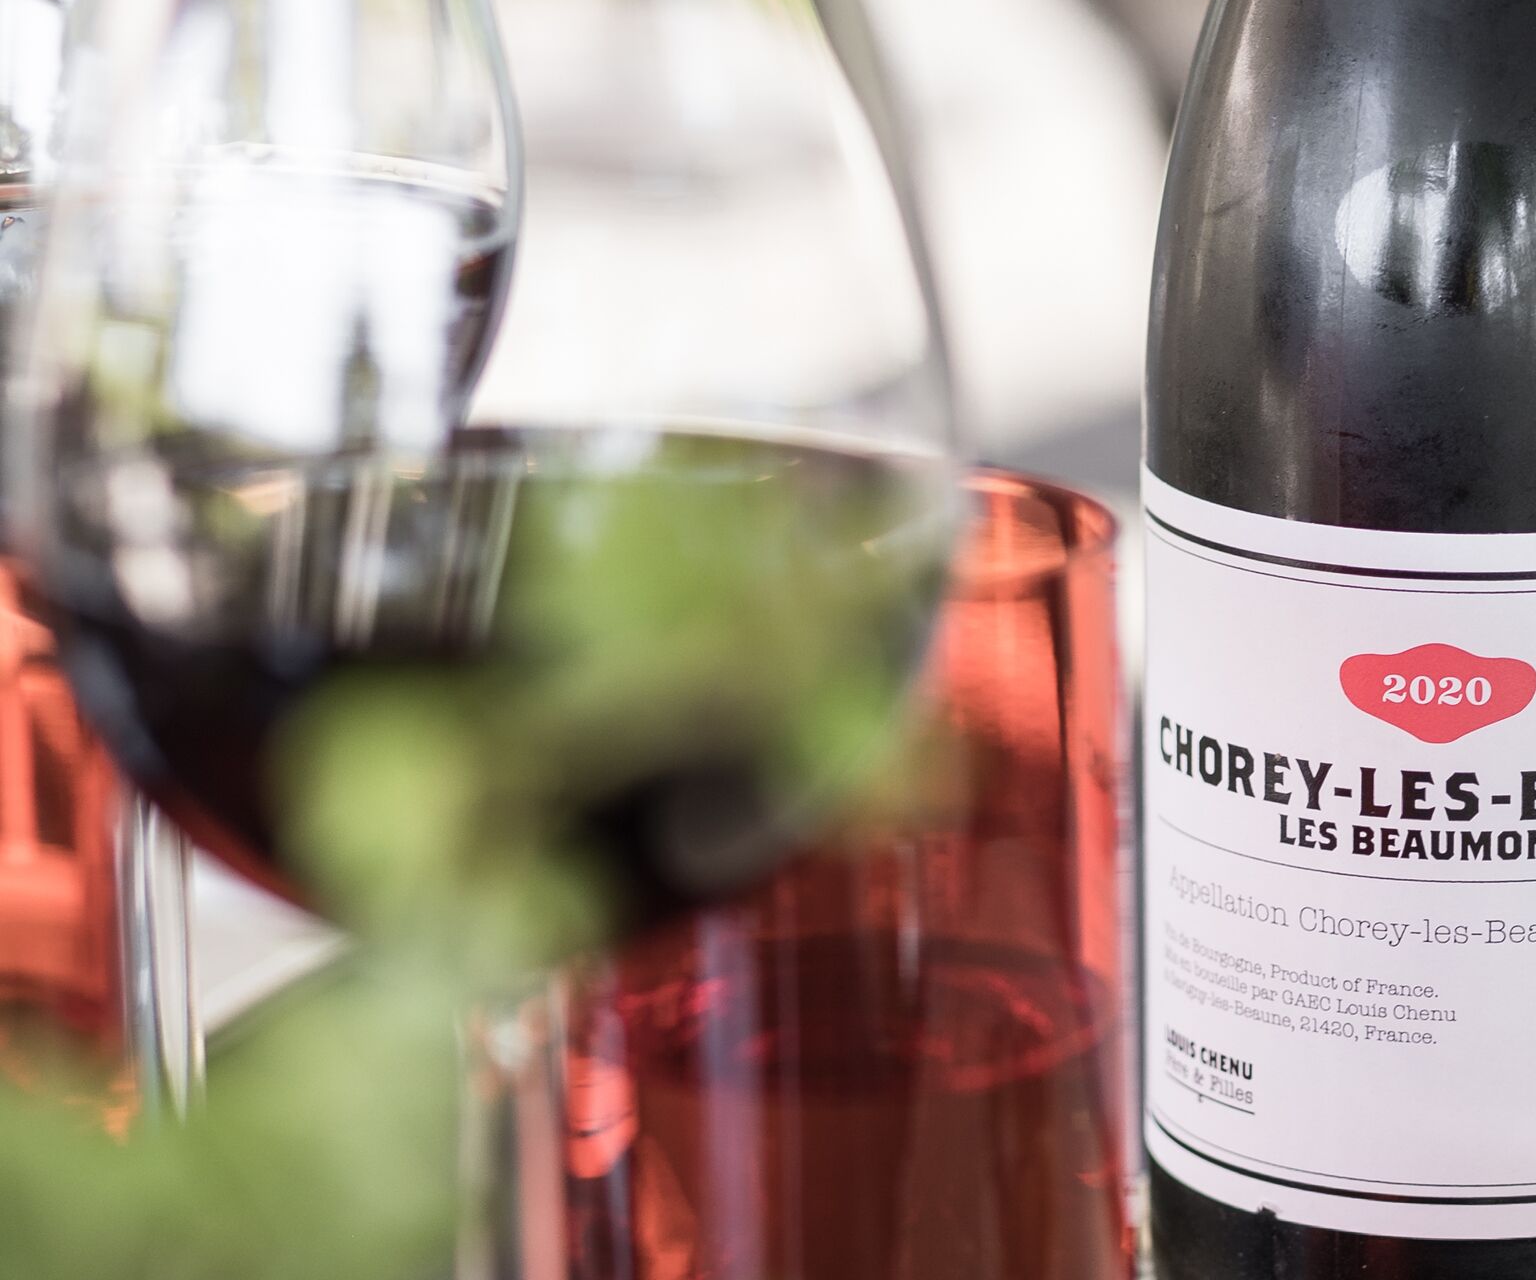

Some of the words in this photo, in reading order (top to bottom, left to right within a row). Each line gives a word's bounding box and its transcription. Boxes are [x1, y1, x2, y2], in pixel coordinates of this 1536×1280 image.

[1382, 673, 1493, 707] 2020
[1279, 813, 1338, 851] LES
[1170, 865, 1289, 927] Appellation
[1191, 937, 1266, 980] Bourgogne,
[1270, 963, 1338, 990] Product
[1342, 978, 1362, 993] of
[1366, 978, 1439, 998] France.
[1193, 960, 1248, 994] bouteille
[1251, 984, 1278, 1002] par
[1282, 989, 1331, 1012] GAEC
[1337, 998, 1388, 1019] Louis
[1393, 1003, 1457, 1022] Chenu
[1165, 1024, 1195, 1058] LOUIS
[1200, 1047, 1253, 1080] CHENU
[1299, 1015, 1359, 1041] 21420,
[1364, 1024, 1437, 1045] France.
[1209, 1074, 1254, 1104] Filles
